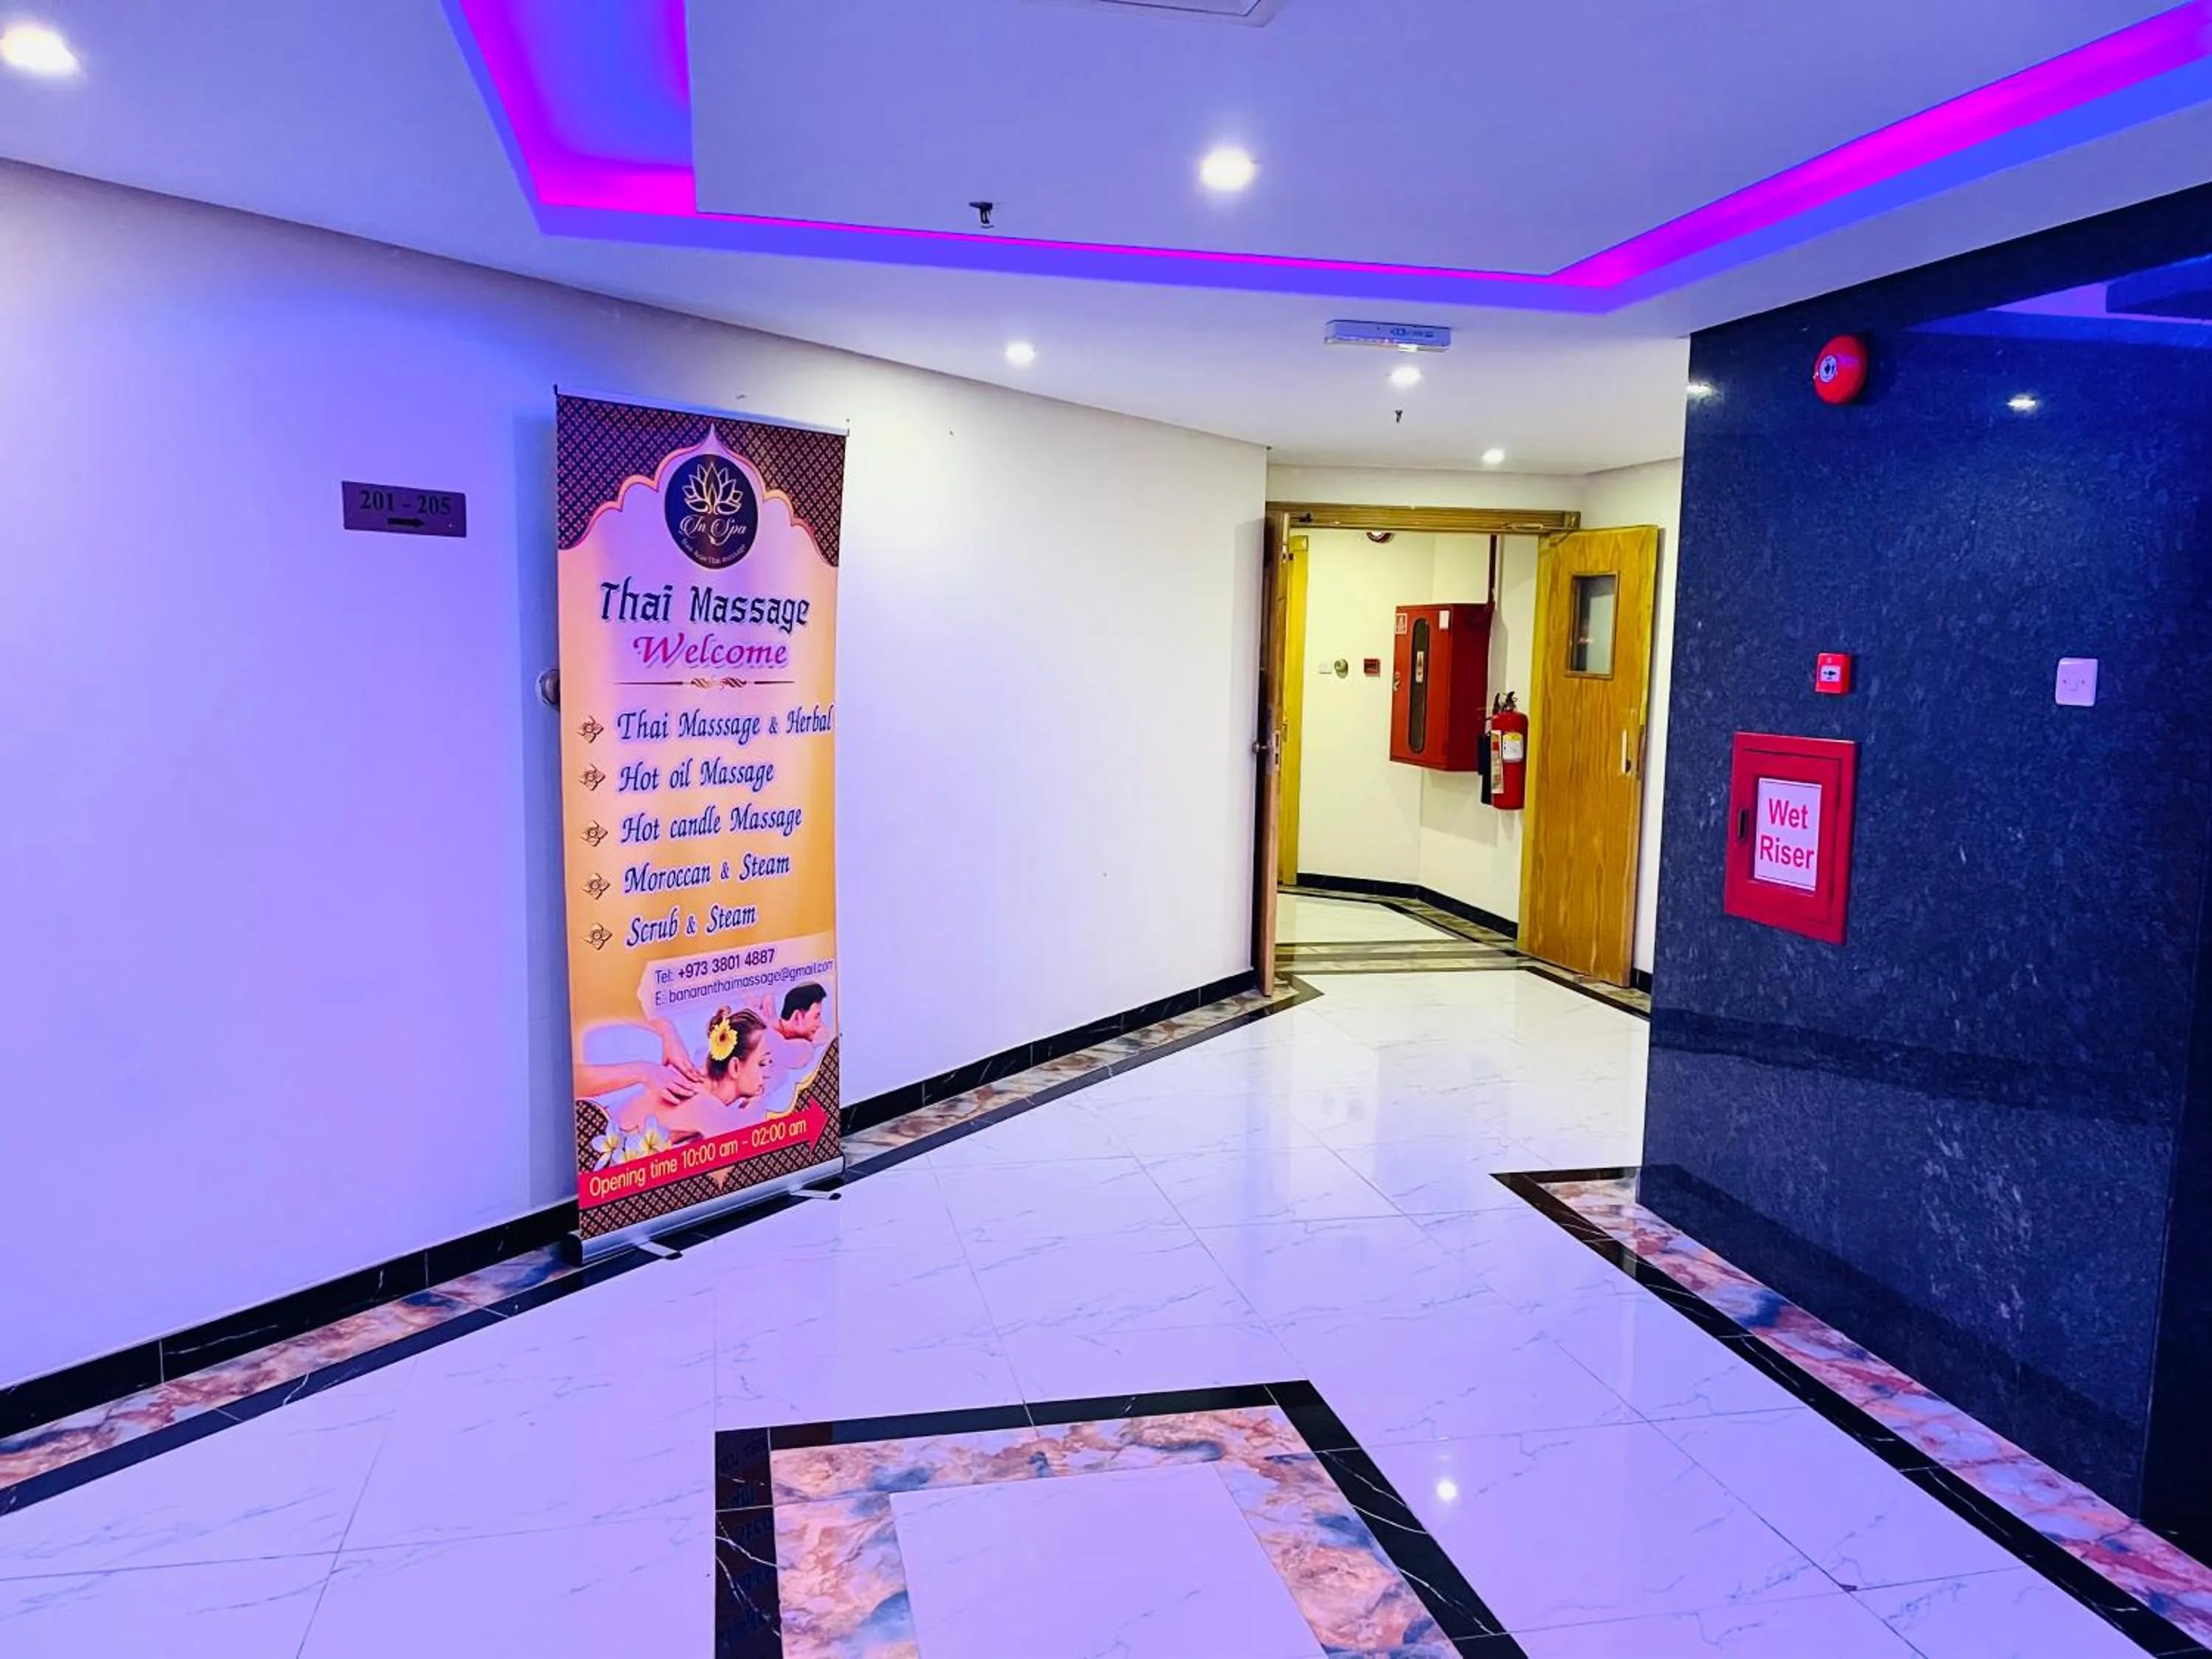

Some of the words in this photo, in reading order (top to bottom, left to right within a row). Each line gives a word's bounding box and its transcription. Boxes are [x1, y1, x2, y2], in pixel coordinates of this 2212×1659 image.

[360, 490, 394, 512] 201
[417, 495, 451, 515] 205
[709, 518, 747, 546] Spa
[600, 576, 673, 622] Thai
[689, 585, 810, 634] Massage
[633, 633, 788, 667] Welcome
[617, 709, 669, 740] Thai
[678, 708, 760, 745] Masssage
[768, 717, 778, 734] &
[786, 703, 834, 734] Herbal
[619, 761, 659, 792] Hot
[669, 758, 693, 788] oil
[700, 757, 774, 793] Massage
[621, 812, 661, 844] Hot
[669, 804, 720, 838] candle
[729, 803, 801, 837] Massage
[1769, 797, 1809, 830] Wet
[1759, 834, 1815, 869] Riser
[625, 862, 711, 894] Moroccan
[720, 861, 729, 880] &
[739, 852, 790, 881] Steam
[627, 907, 678, 947] Scrub
[686, 916, 695, 934] &
[706, 905, 756, 933] Steam
[678, 961, 709, 978] +973
[712, 954, 740, 973] 3801
[744, 948, 776, 967] 4887
[589, 1167, 646, 1198] Opening
[650, 1158, 678, 1180] time
[682, 1141, 716, 1169] 10:00
[719, 1138, 739, 1159] am
[751, 1124, 786, 1148] 02:00
[789, 1118, 807, 1138] am
